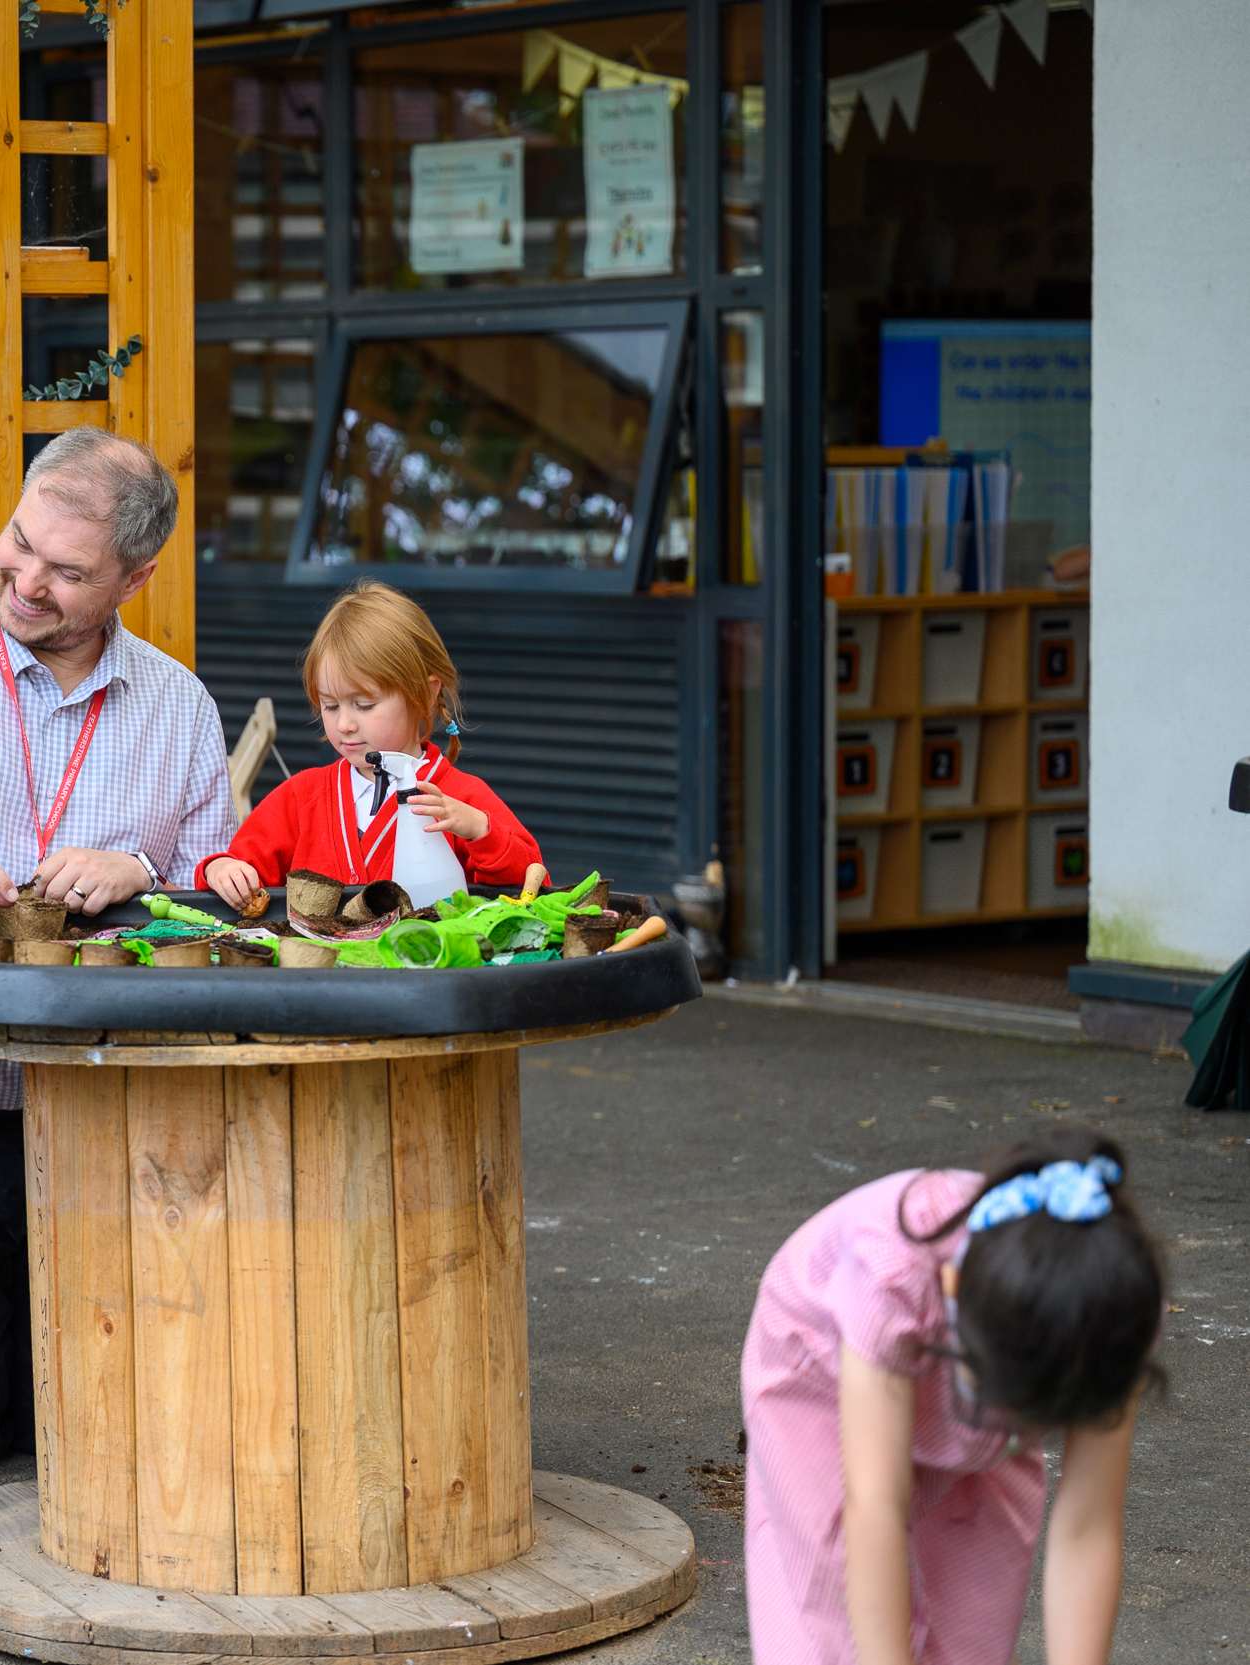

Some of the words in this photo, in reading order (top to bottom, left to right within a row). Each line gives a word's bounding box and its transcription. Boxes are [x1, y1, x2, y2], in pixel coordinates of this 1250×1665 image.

[71, 713, 96, 770] FEATHERSTONE
[936, 753, 949, 778] 2
[1053, 754, 1066, 778] 3
[59, 767, 77, 804] PRIMARY
[46, 801, 63, 831] SCHOOL
